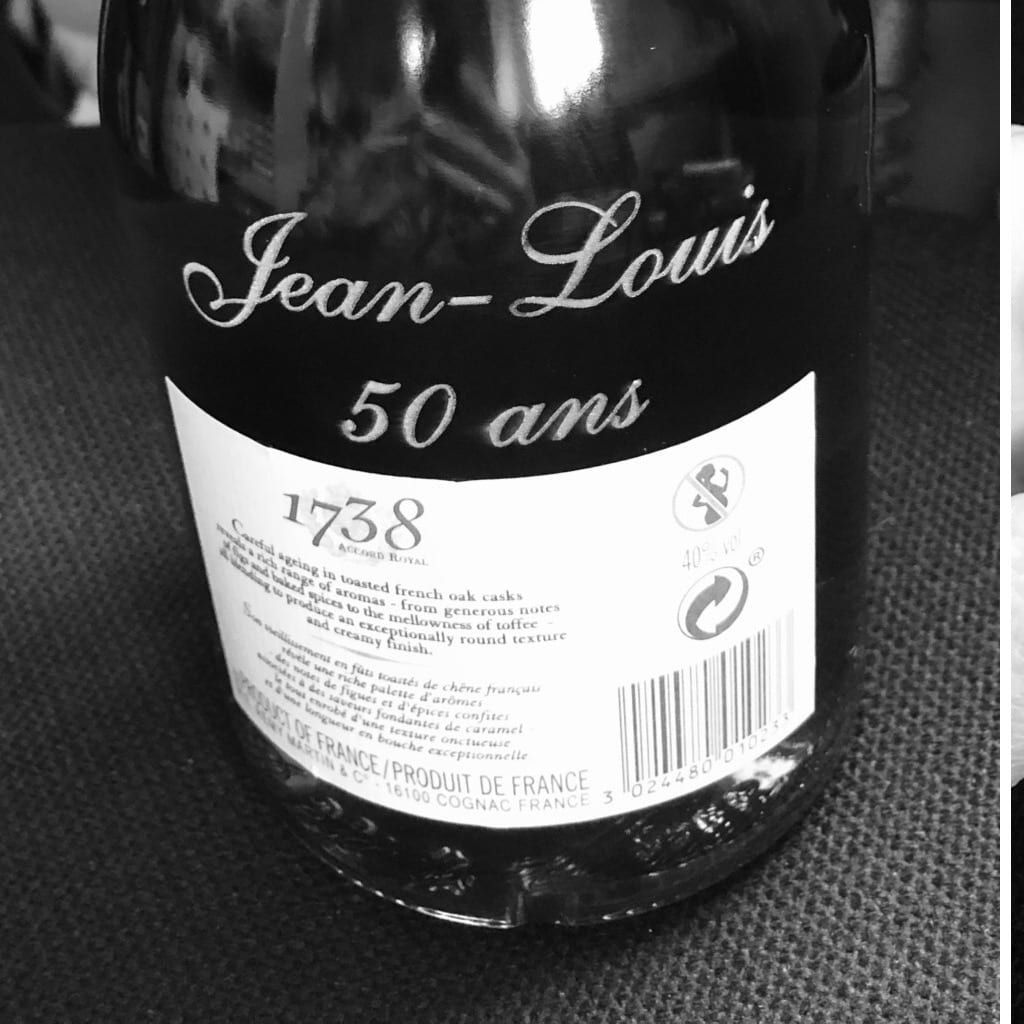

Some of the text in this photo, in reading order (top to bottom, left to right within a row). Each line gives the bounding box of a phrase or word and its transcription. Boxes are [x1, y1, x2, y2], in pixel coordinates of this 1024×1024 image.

[339, 378, 651, 449] 50 ans
[282, 492, 425, 551] 1738
[231, 518, 523, 602] Careful ageing in toasted french oak casks
[281, 567, 314, 586] range
[319, 580, 332, 592] of
[336, 588, 386, 607] aromas
[401, 599, 438, 614] from
[444, 605, 514, 618] generous
[520, 603, 560, 616] notes
[286, 593, 335, 619] produce
[339, 613, 354, 626] an
[359, 619, 454, 646] exceptionally
[460, 633, 506, 645] round
[513, 631, 567, 645] texture
[306, 615, 330, 631] and
[334, 627, 382, 650] creamy
[347, 601, 360, 614] to
[363, 605, 384, 621] the
[389, 612, 473, 631] mellowness
[477, 619, 492, 630] of
[497, 619, 538, 631] toffee
[334, 659, 348, 671] en
[424, 679, 438, 690] de
[443, 681, 482, 694] chêne
[370, 681, 415, 700] palette
[381, 697, 393, 708] et
[359, 730, 373, 741] en
[378, 733, 424, 753] bouche
[445, 722, 460, 733] de
[465, 724, 524, 735] caramel
[385, 781, 431, 804] 16100
[437, 792, 512, 813] COGNAC
[519, 792, 590, 813] FRANCE
[480, 775, 505, 796] DE
[512, 769, 590, 796] FRANCE
[602, 790, 613, 805] 3
[631, 759, 713, 798] 024480
